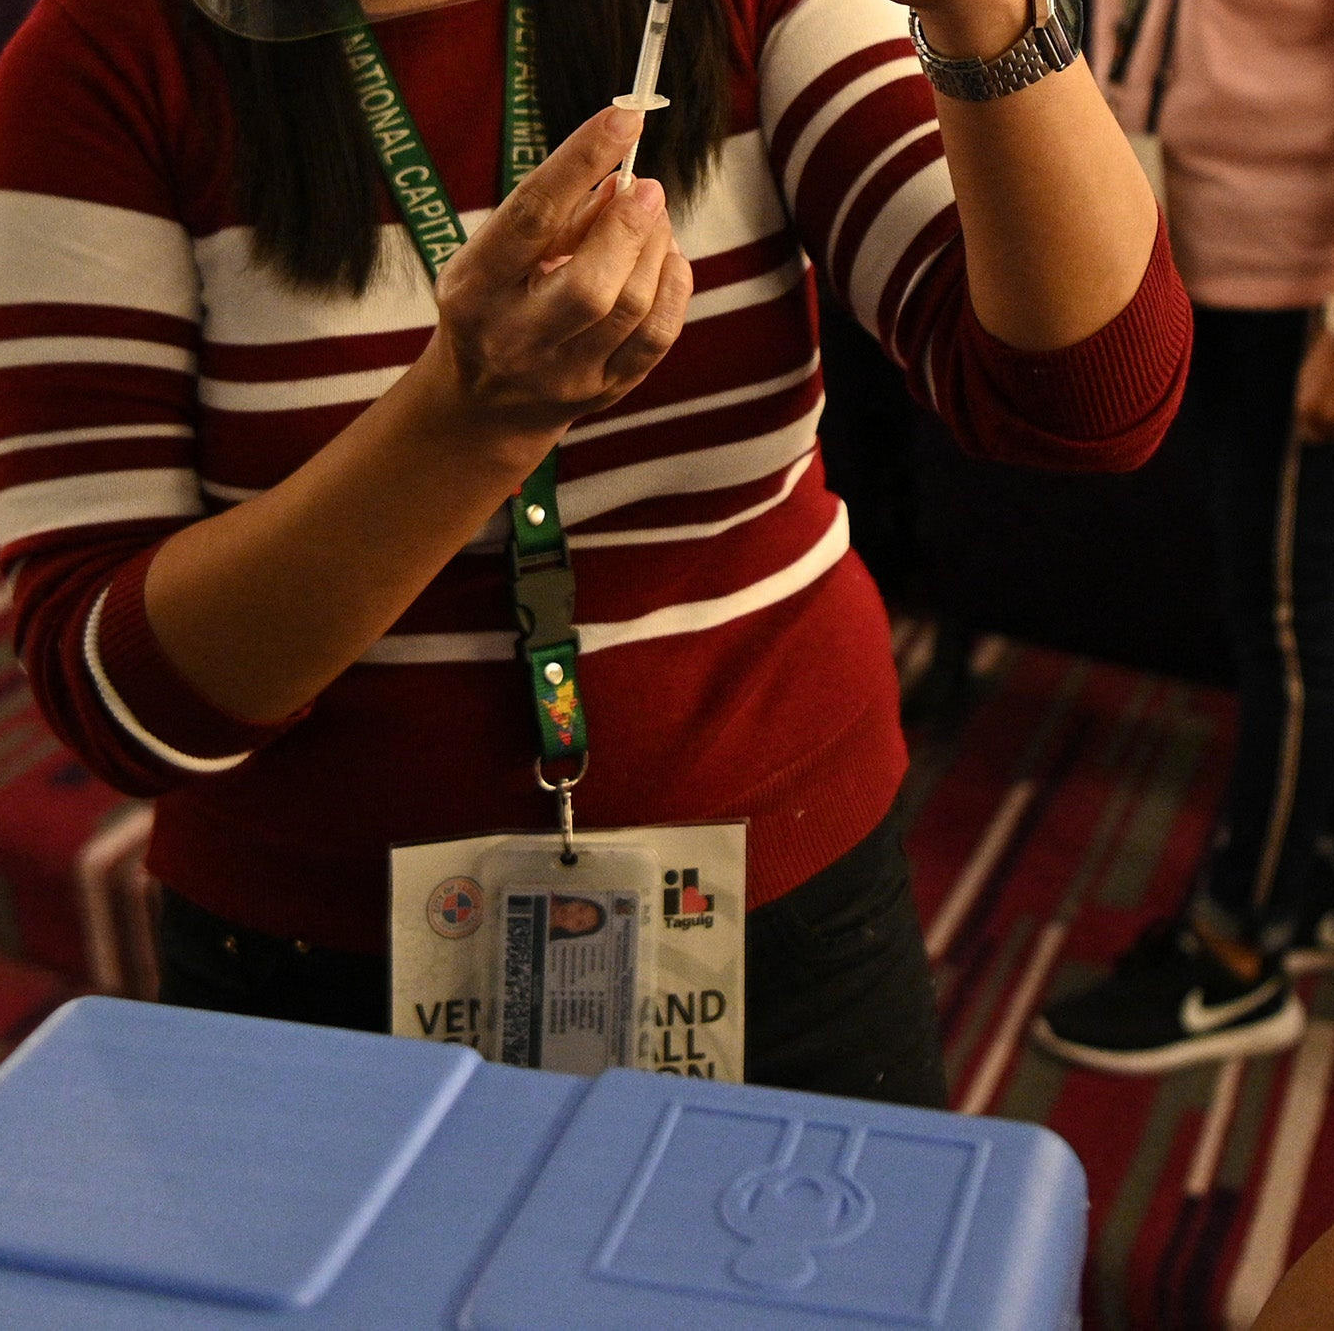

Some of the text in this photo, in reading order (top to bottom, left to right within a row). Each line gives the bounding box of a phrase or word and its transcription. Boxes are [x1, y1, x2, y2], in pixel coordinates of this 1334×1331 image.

[342, 31, 462, 273] NATIONAL CAPITA
[663, 914, 714, 930] Taguig
